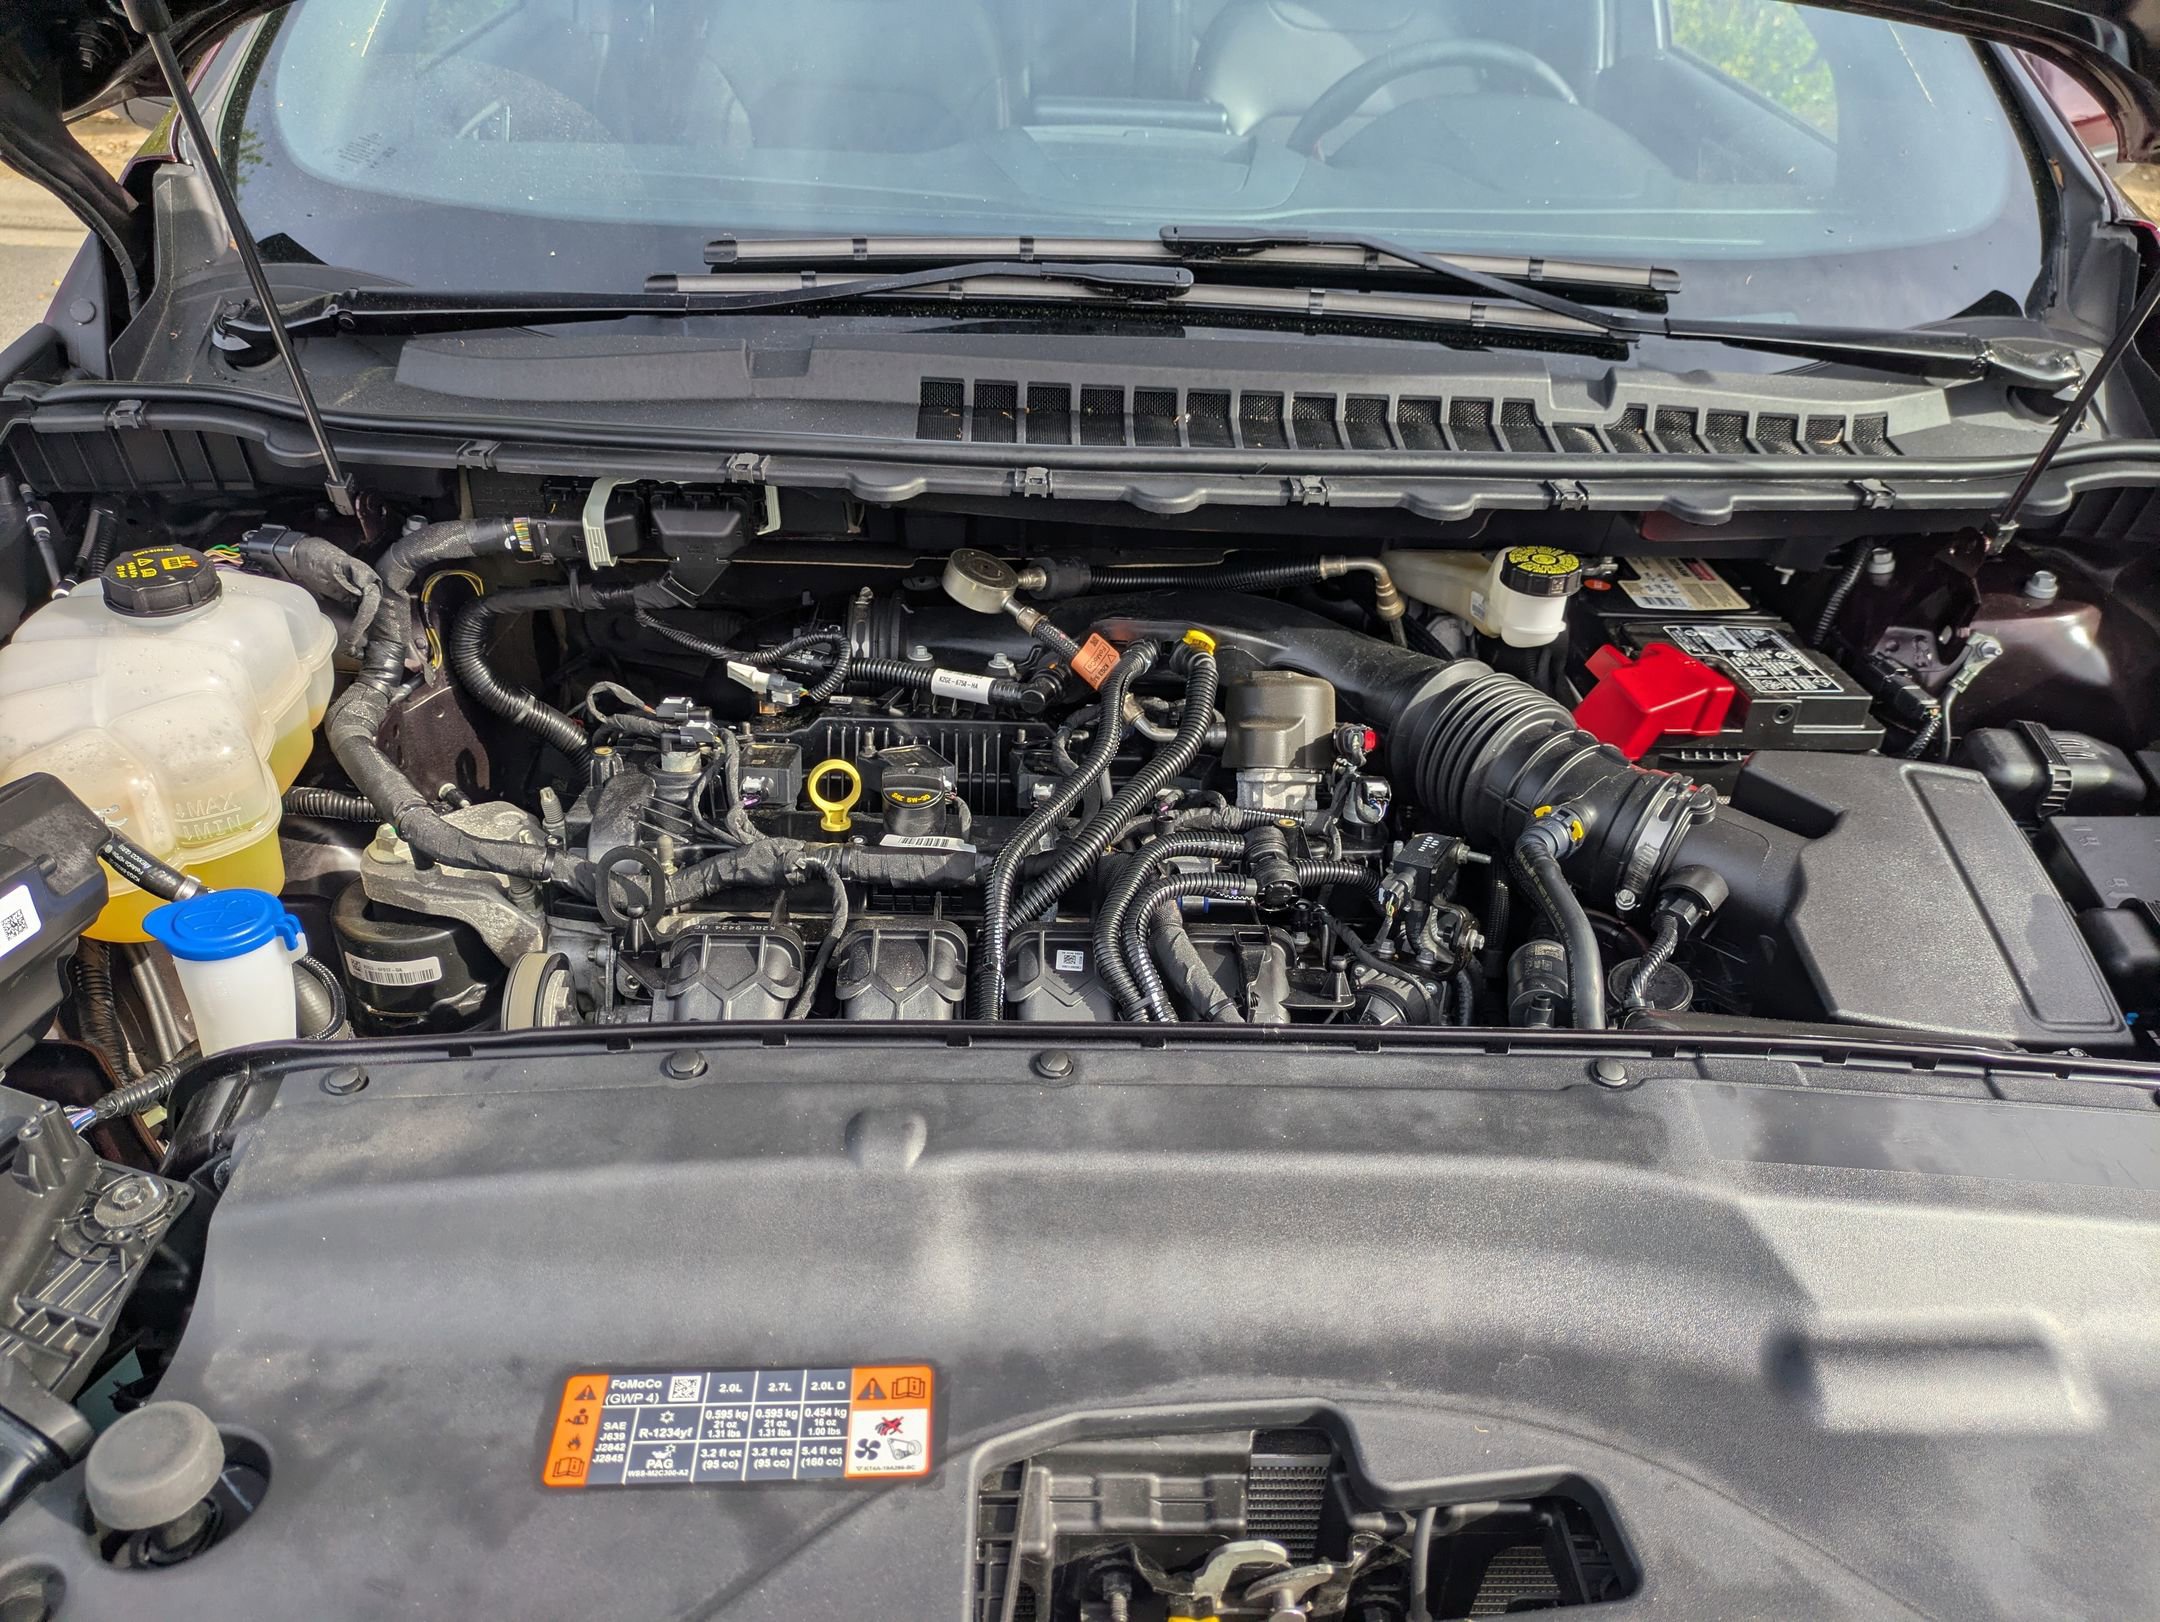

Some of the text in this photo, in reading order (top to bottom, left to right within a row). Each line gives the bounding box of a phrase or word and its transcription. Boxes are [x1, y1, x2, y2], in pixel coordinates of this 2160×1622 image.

[1087, 645, 1107, 669] FoMoCo
[891, 792, 904, 801] SAE
[186, 791, 238, 817] MAX
[194, 814, 242, 841] MIN
[611, 1379, 662, 1390] FoMoCo
[718, 1383, 743, 1393] 2.0L
[767, 1382, 792, 1392] 2.7L
[810, 1381, 846, 1391] 2.0L D
[605, 1393, 660, 1405] (GWP 4)
[705, 1409, 749, 1421] 0.595 kg
[755, 1408, 798, 1420] 0.595 kg
[804, 1407, 847, 1419] 0.454 kg
[603, 1421, 627, 1430] SAE
[713, 1420, 725, 1429] 21
[763, 1420, 775, 1428] 21
[600, 1432, 625, 1441] J639
[638, 1427, 693, 1439] R-1234yf
[707, 1429, 741, 1438] 1.31 lbs
[757, 1428, 792, 1437] 1.31 lbs
[807, 1427, 841, 1436] 1.00 lbs
[595, 1443, 626, 1452] J2842
[751, 1447, 793, 1456] 3.2 fl oz
[801, 1446, 842, 1455] 5.4 fl oz
[700, 1448, 742, 1458] 3.2 fl oz
[646, 1459, 674, 1469] PAG
[702, 1459, 739, 1471] (95 cc)
[753, 1458, 790, 1470] (95 cc)
[800, 1457, 843, 1468] (160 cc)
